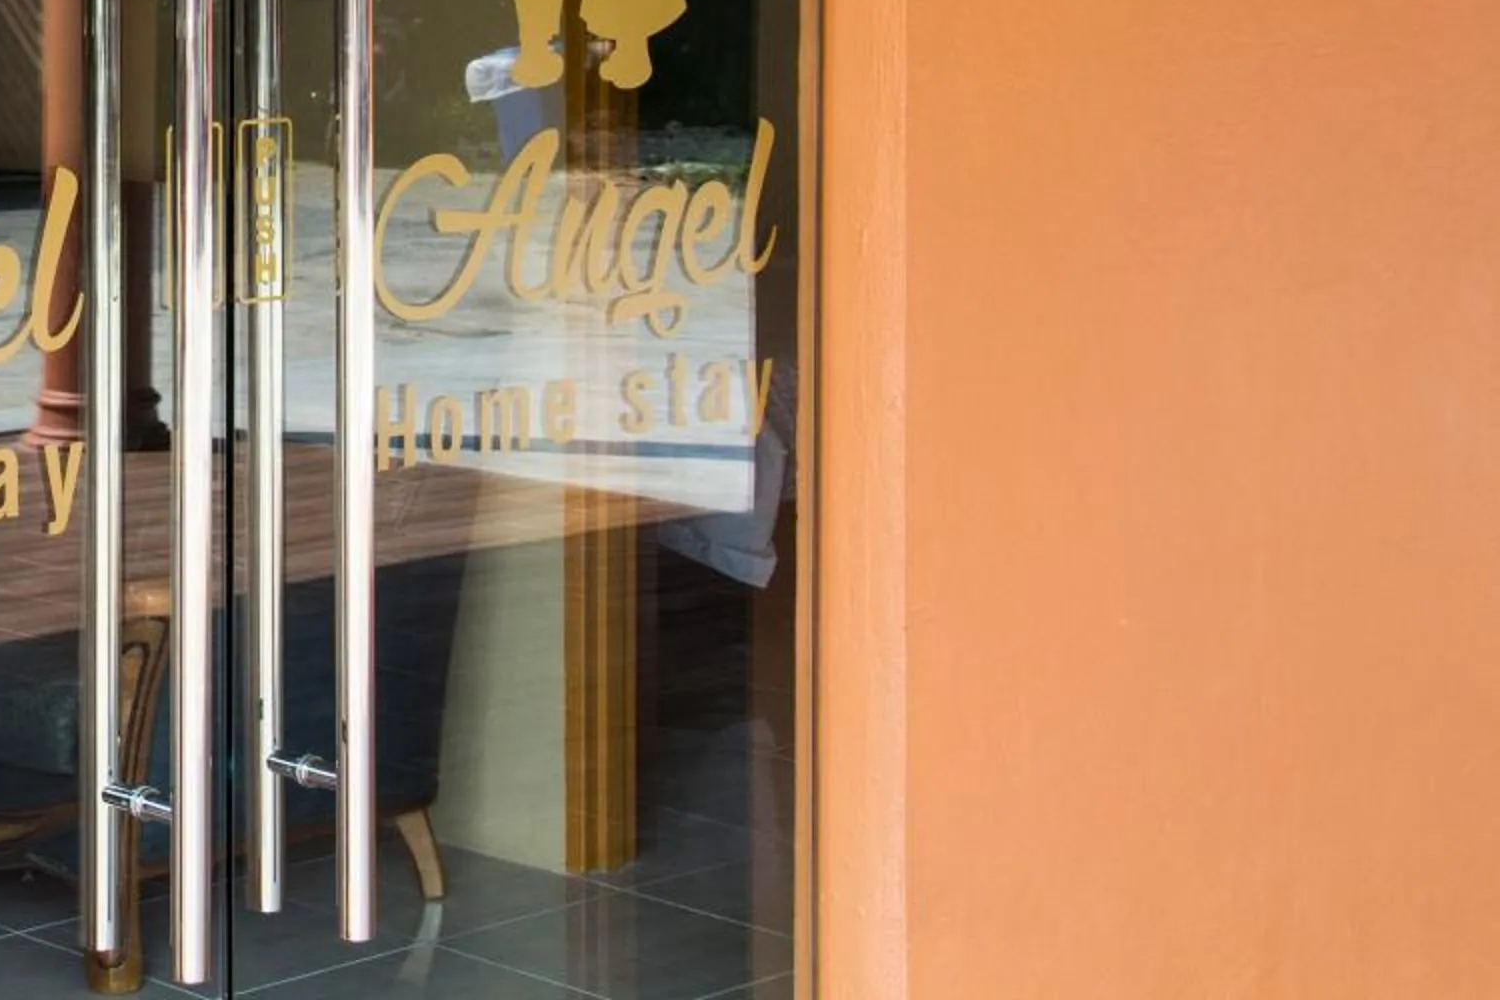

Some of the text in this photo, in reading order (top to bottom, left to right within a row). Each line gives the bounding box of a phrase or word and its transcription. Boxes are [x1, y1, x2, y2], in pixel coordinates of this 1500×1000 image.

[373, 116, 778, 339] Angel
[376, 352, 773, 473] Home stay
